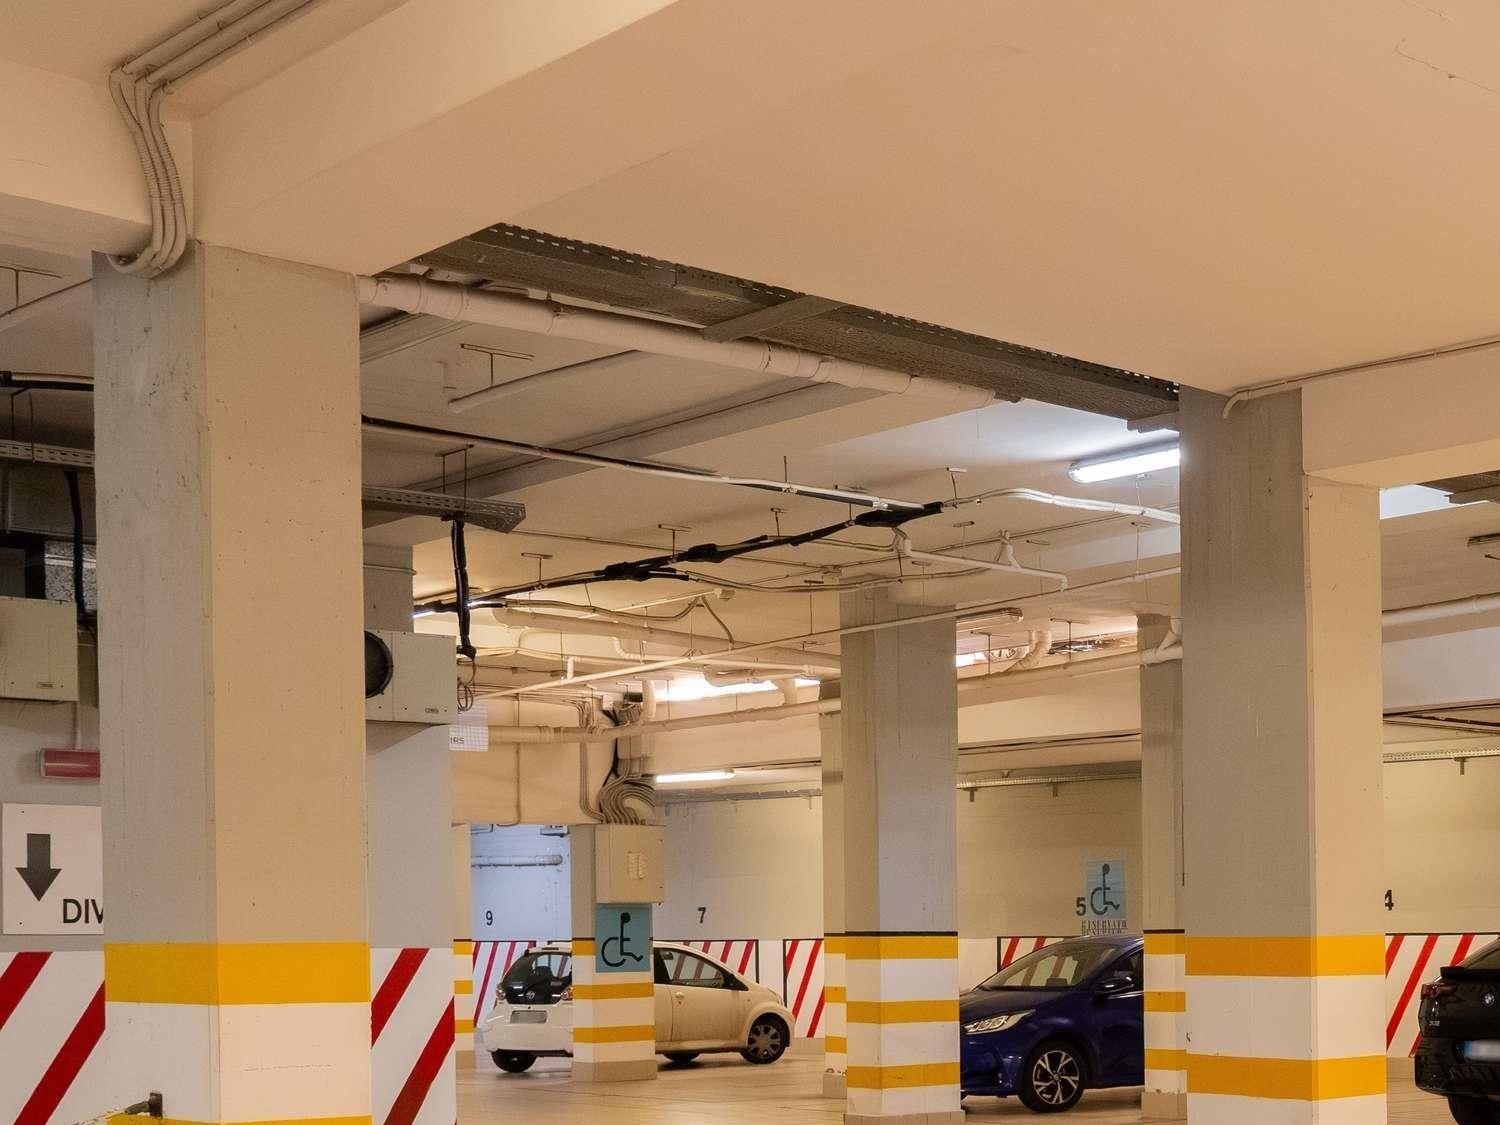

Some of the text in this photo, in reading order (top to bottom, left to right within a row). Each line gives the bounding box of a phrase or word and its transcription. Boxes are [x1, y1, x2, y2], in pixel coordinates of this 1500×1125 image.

[1076, 896, 1086, 916] 5
[1385, 889, 1394, 911] 4
[485, 910, 493, 926] 9
[697, 907, 706, 923] 7
